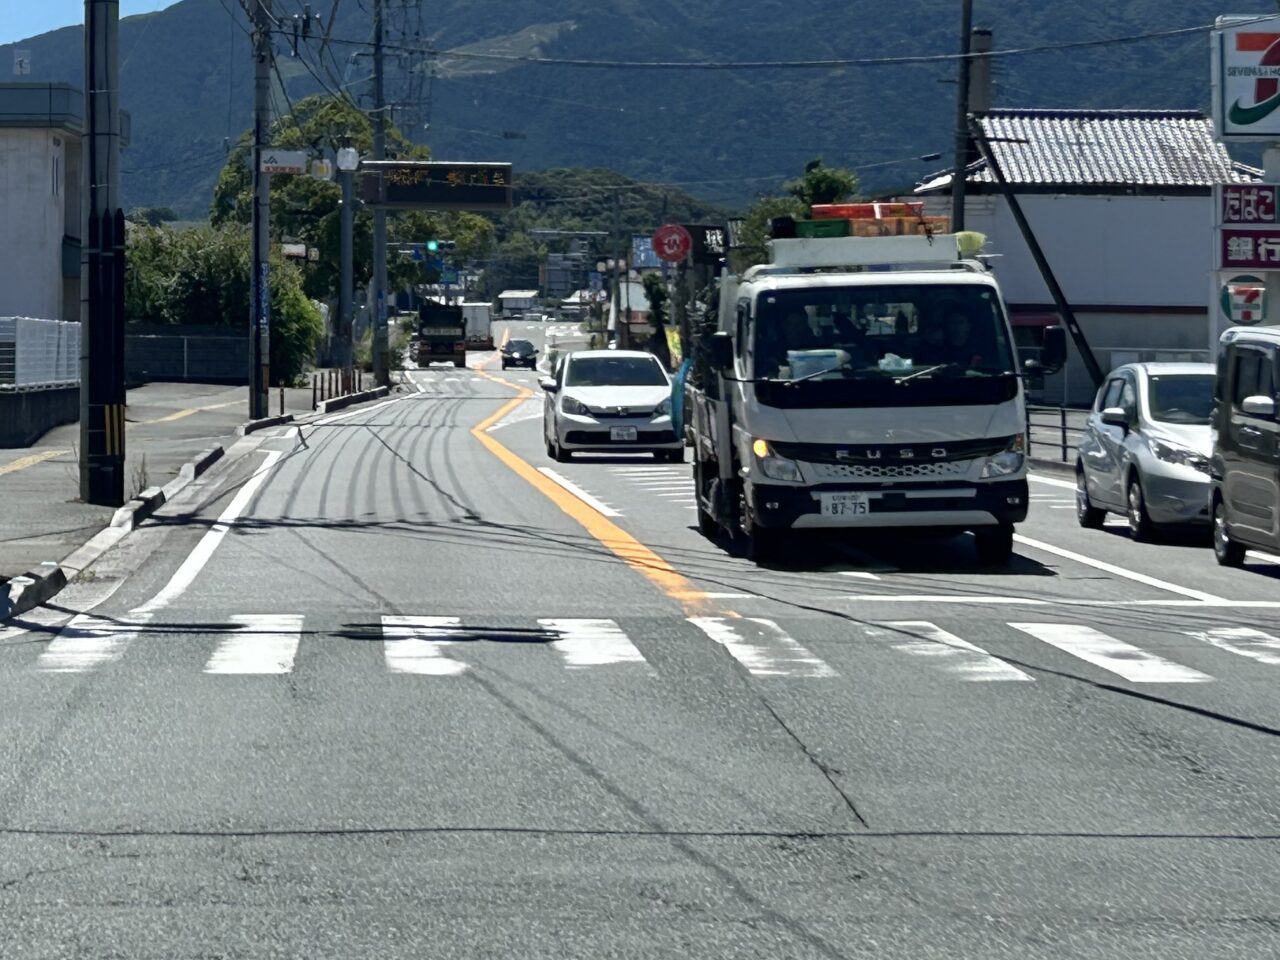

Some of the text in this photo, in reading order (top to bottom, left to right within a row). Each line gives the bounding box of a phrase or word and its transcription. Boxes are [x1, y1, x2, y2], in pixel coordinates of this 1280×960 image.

[1223, 189, 1275, 221] たばこ
[1227, 236, 1280, 261] 銀行
[836, 448, 946, 458] FUSO
